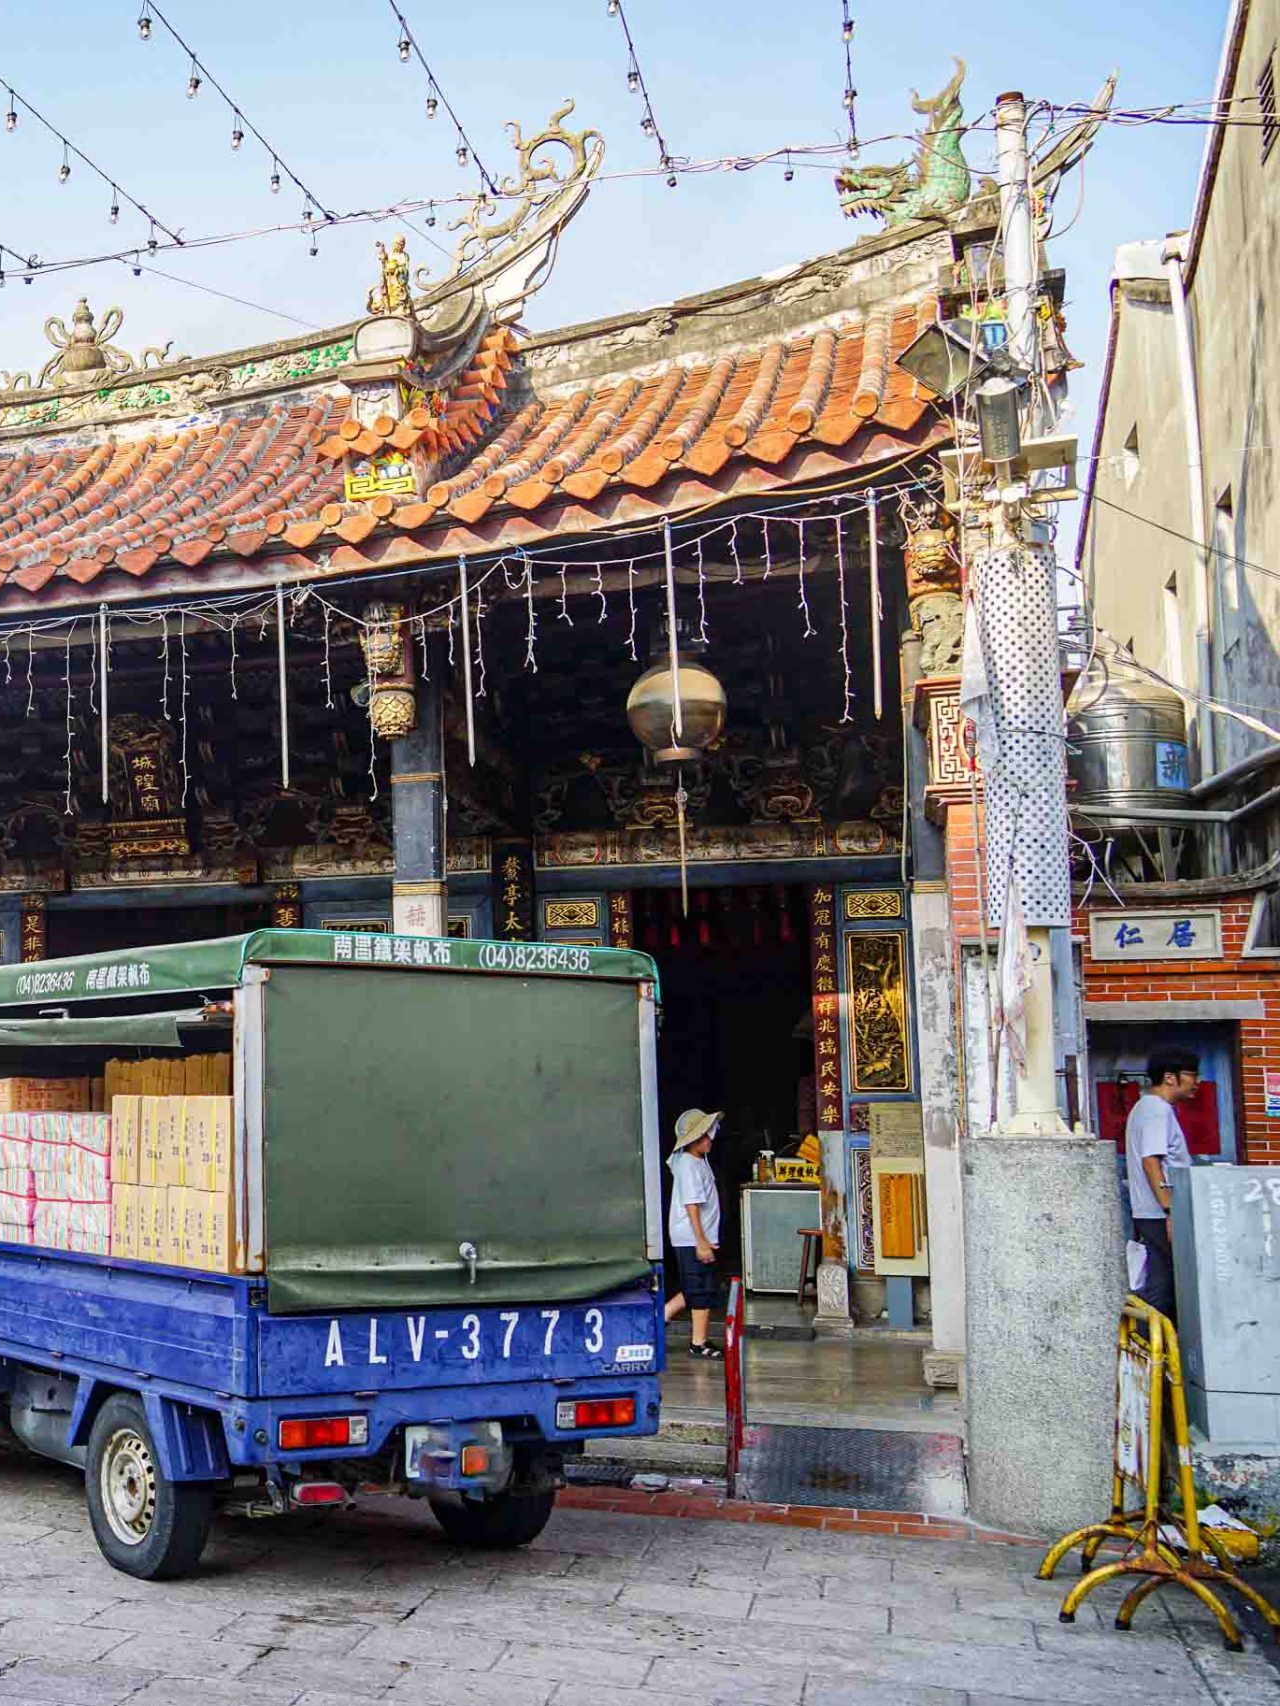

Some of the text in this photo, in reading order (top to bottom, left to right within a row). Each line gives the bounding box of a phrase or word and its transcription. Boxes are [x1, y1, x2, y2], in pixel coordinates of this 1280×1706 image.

[479, 945, 590, 971] (04)8236436
[16, 971, 75, 996] (04)8236436
[324, 1308, 604, 1367] ALV-3773
[602, 1362, 650, 1373] CARRY
